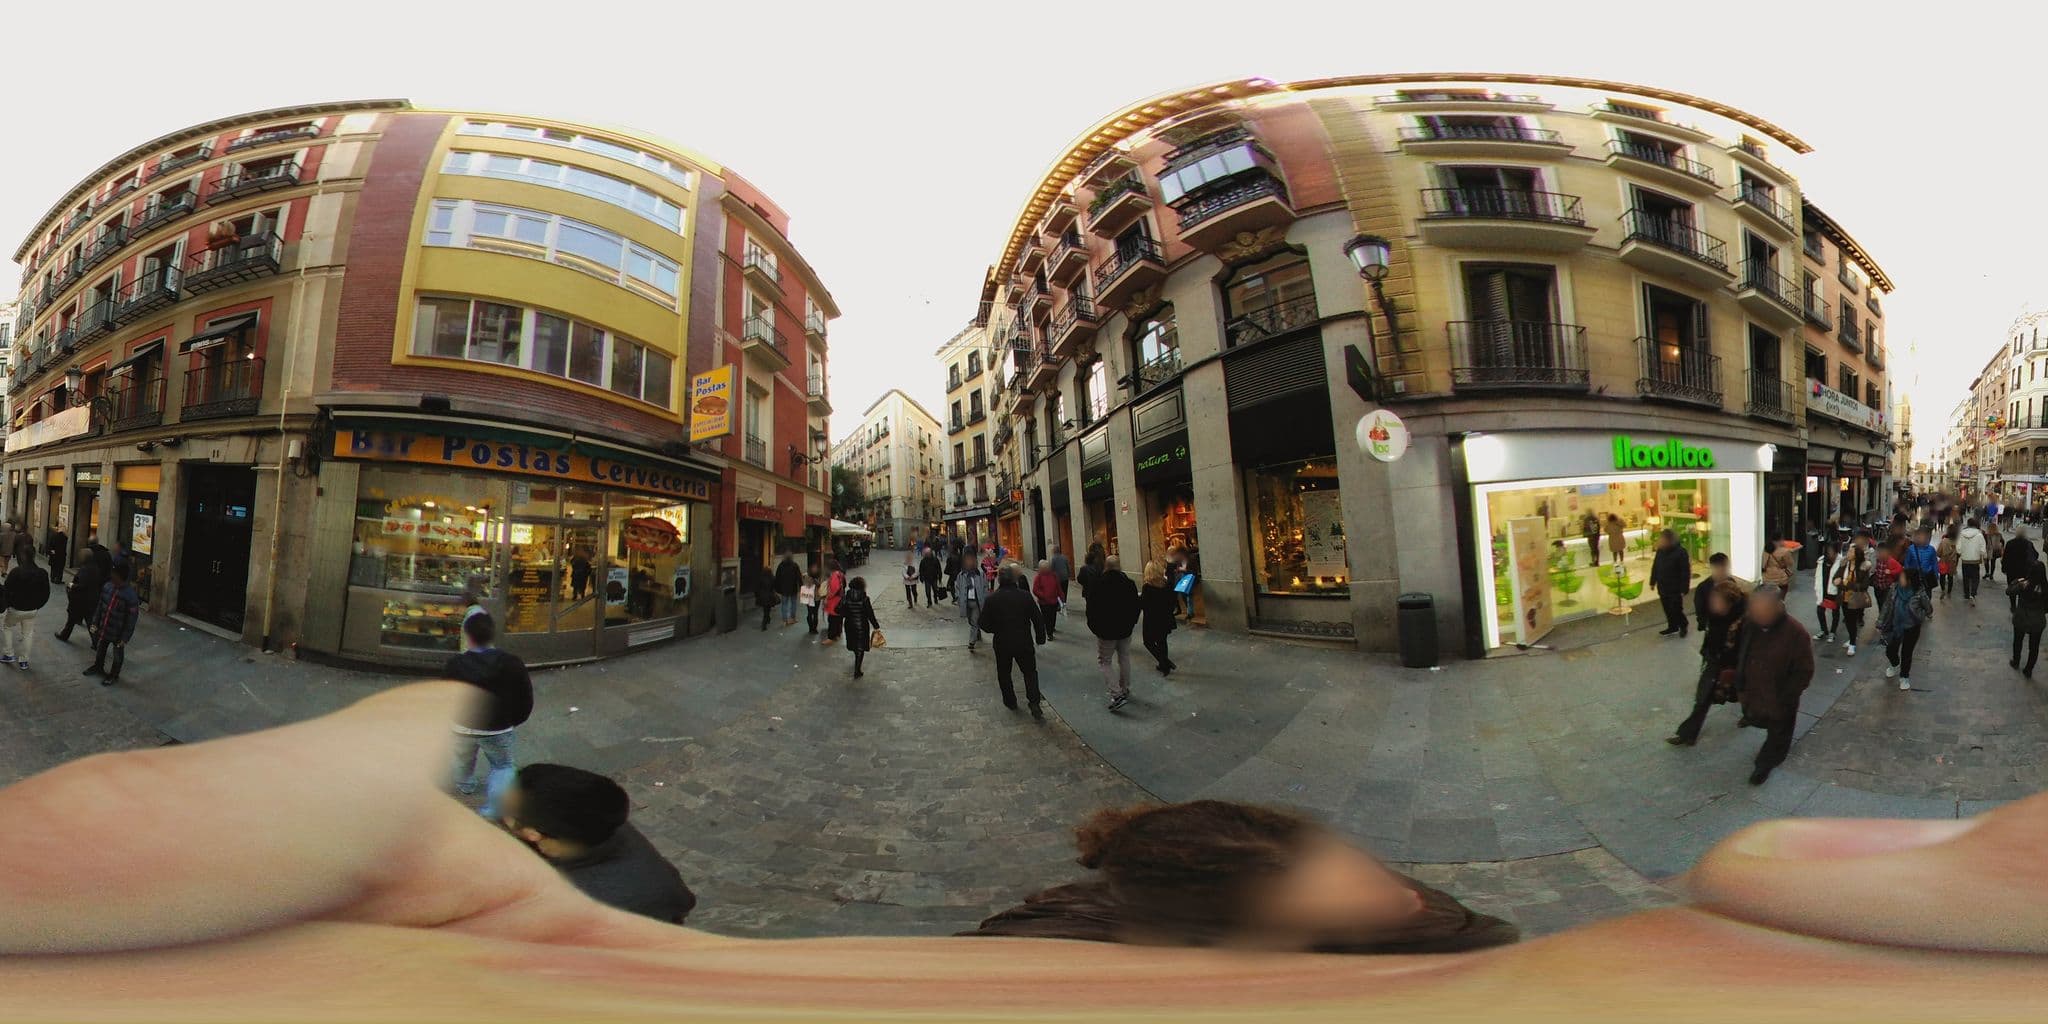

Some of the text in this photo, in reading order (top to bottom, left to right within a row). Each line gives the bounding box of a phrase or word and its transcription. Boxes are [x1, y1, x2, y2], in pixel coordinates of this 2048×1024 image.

[696, 382, 726, 397] Postas
[697, 376, 712, 387] Bar
[1612, 434, 1713, 469] llaollao
[351, 430, 706, 497] Bar Postas Cerveceria
[1137, 453, 1170, 471] natura
